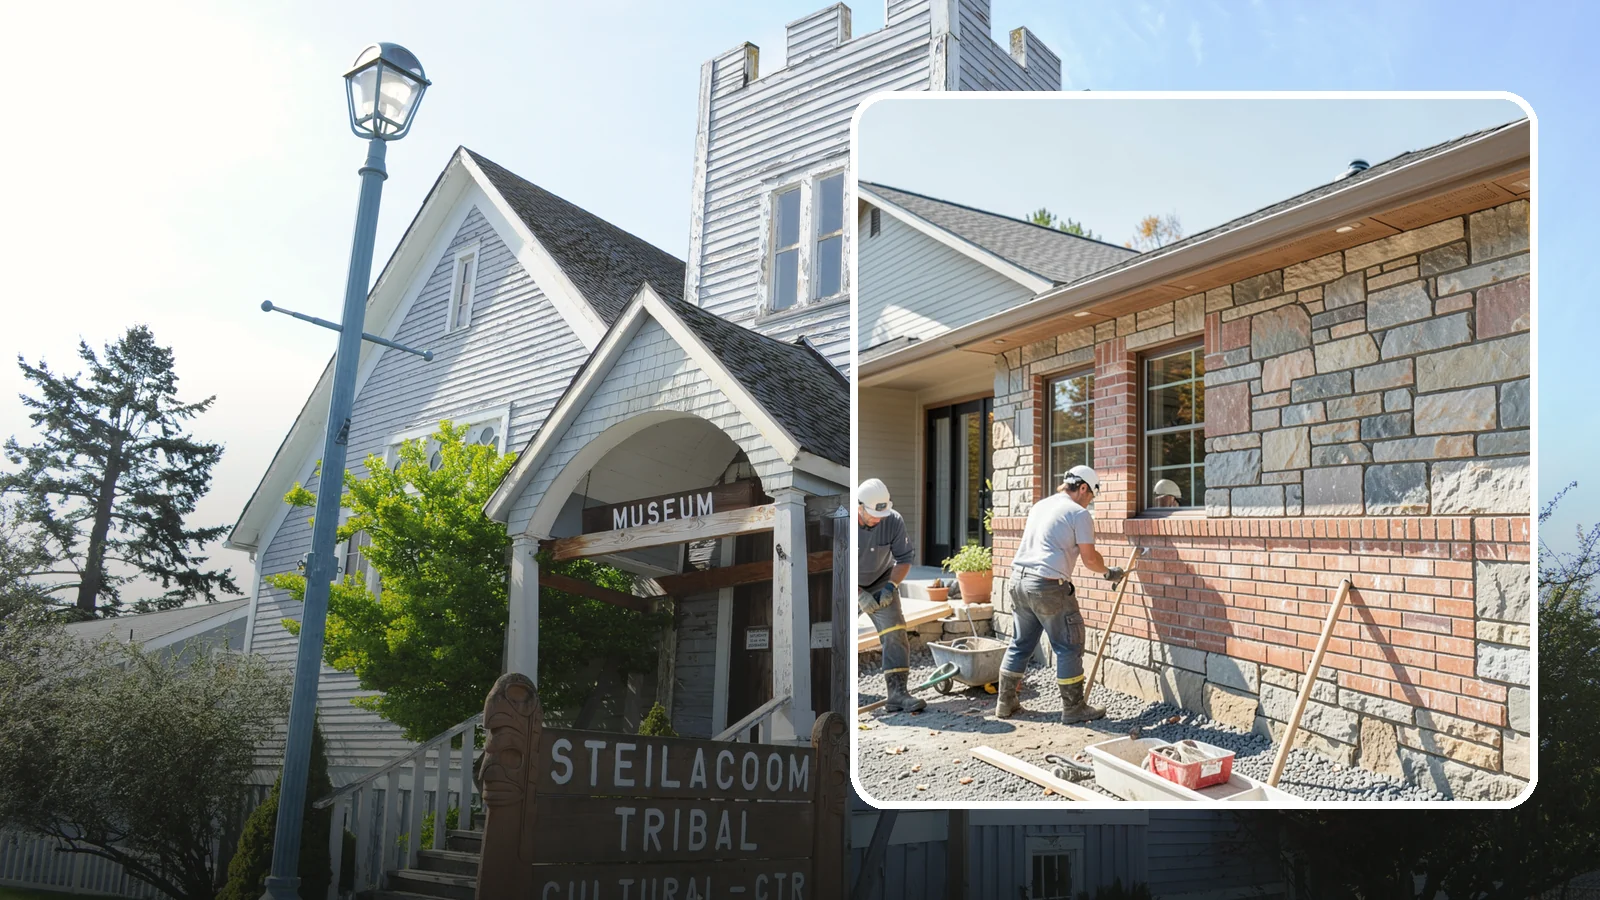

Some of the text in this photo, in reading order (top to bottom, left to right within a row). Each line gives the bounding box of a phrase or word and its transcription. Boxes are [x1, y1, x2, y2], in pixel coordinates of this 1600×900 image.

[612, 491, 713, 531] MUSEUM
[550, 738, 809, 792] STEILACOOM
[614, 806, 757, 852] TRIBAL
